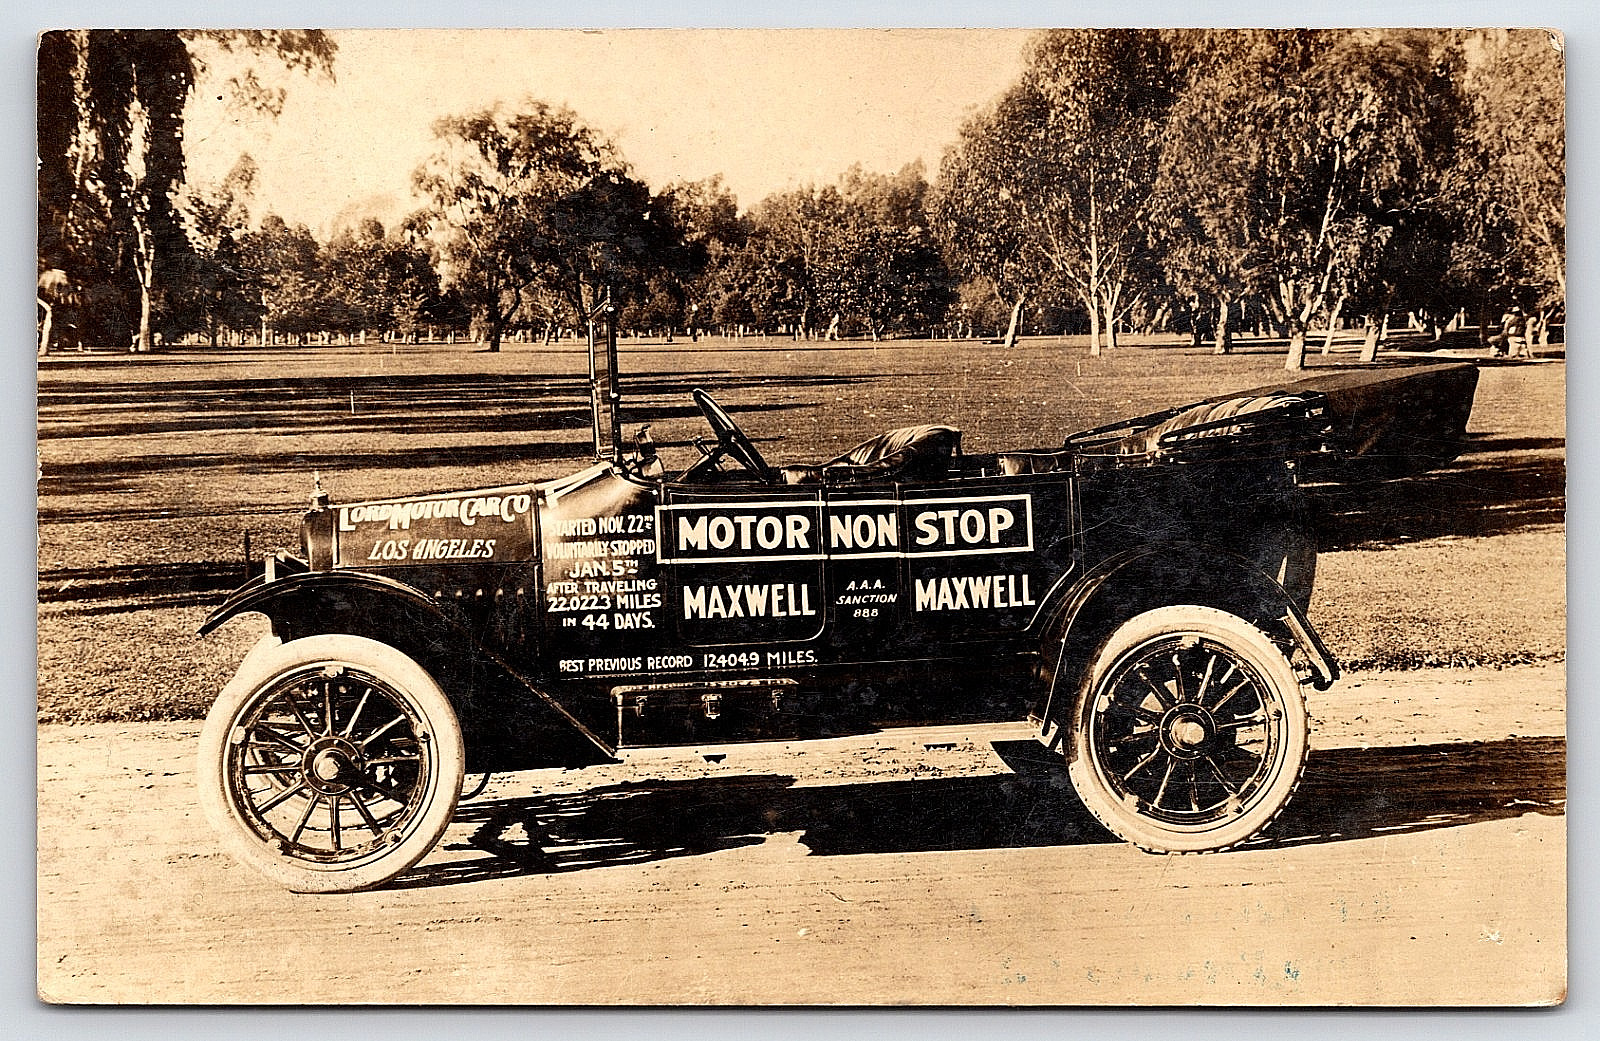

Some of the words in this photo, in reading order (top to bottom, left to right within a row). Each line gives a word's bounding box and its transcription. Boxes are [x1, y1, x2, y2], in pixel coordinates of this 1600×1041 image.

[599, 515, 626, 534] NOV.
[677, 514, 811, 551] MOTOR
[829, 512, 898, 549] NON
[914, 507, 1015, 546] STOP
[368, 539, 410, 560] LOS
[413, 539, 497, 560] ANGELES
[546, 540, 609, 559] VOLUNTARILY
[610, 538, 656, 557] STOPPED
[569, 560, 610, 578] JAN.
[611, 559, 639, 577] 5TH
[547, 581, 578, 594] AFTER
[584, 578, 658, 594] TRAVELING
[846, 579, 886, 591] A.A.A.
[915, 574, 1036, 612] MAXWELL
[617, 593, 662, 610] MILES
[683, 583, 816, 620] MAXWELL
[835, 593, 898, 605] SANCTION
[562, 617, 577, 627] IN
[581, 613, 610, 631] 44
[614, 611, 656, 630] DAYS.
[853, 608, 879, 618] 888
[559, 659, 585, 673] BEST
[588, 656, 642, 672] PREVIOUS
[647, 655, 693, 670] RECORD
[767, 649, 819, 666] MILES.
